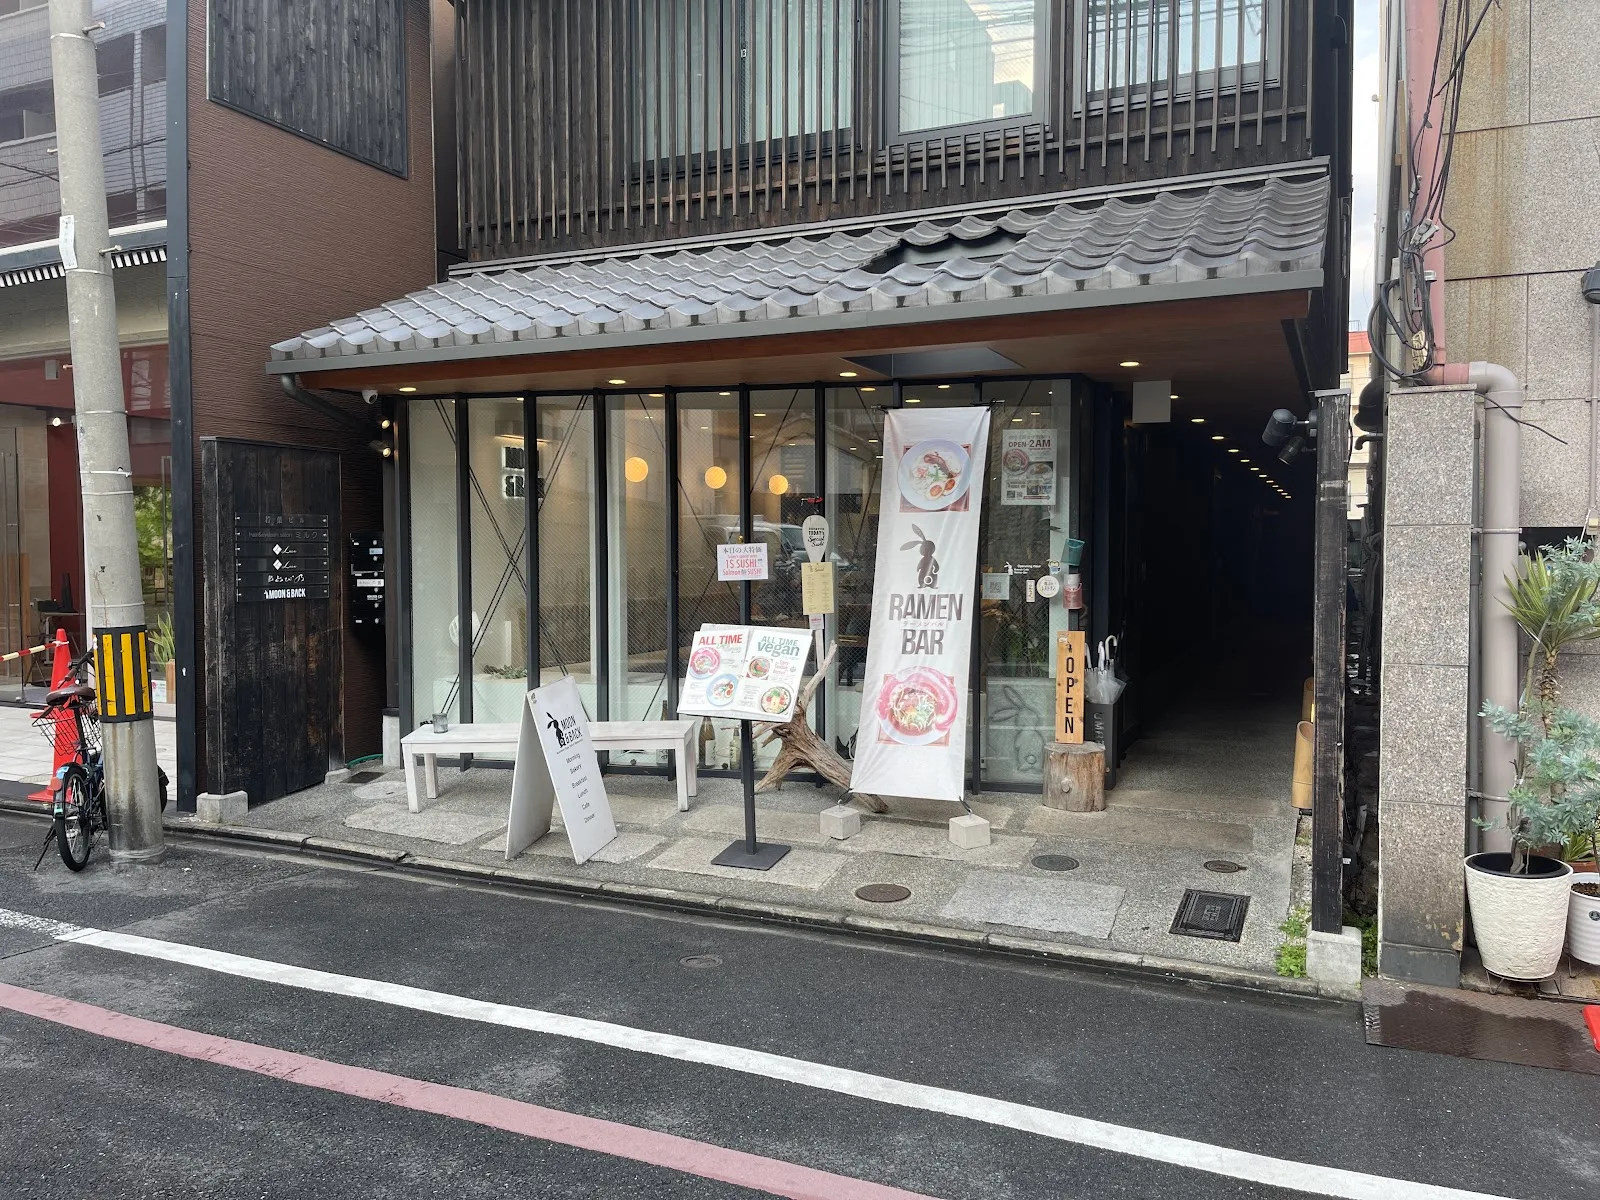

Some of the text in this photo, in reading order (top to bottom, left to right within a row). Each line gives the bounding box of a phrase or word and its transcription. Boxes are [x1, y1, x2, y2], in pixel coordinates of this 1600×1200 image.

[296, 531, 318, 539] ミルク
[737, 558, 757, 568] SUSHI
[269, 589, 286, 599] MOON
[291, 588, 306, 598] BACK
[888, 593, 963, 621] RAMEN
[698, 634, 743, 645] ALL TIME
[761, 635, 799, 647] ALL TIME
[901, 629, 944, 655] BAR
[757, 641, 800, 657] vegan
[1064, 657, 1075, 734] OPEN
[560, 715, 577, 731] MOON
[570, 727, 583, 742] BACK
[566, 753, 581, 764] Morning
